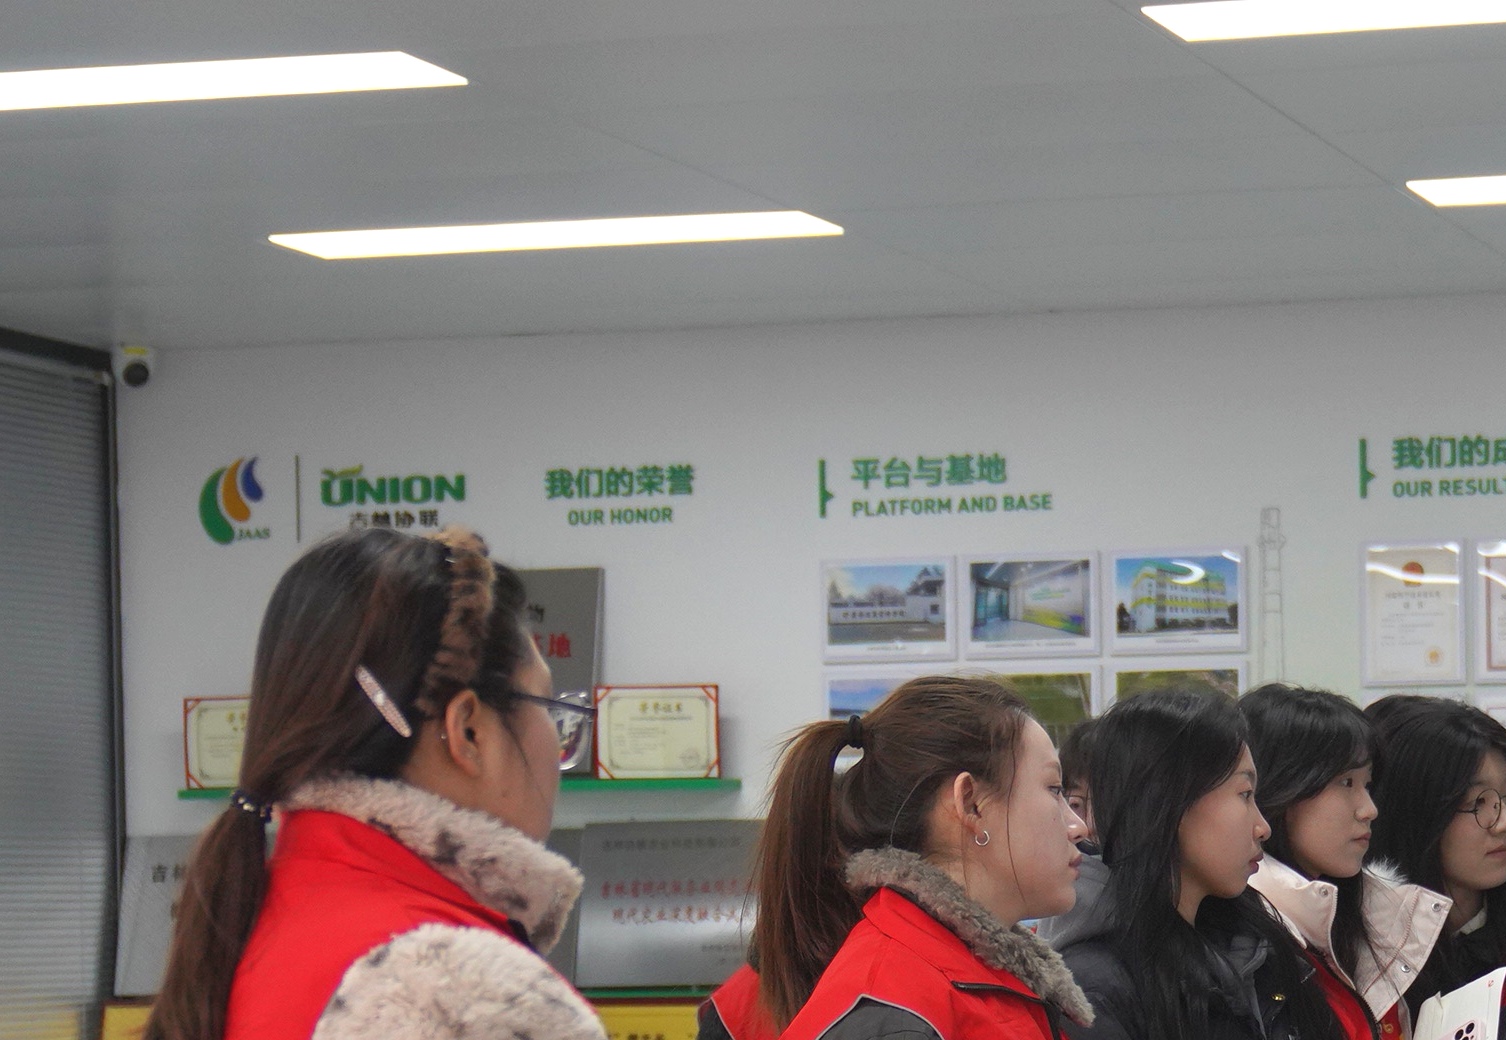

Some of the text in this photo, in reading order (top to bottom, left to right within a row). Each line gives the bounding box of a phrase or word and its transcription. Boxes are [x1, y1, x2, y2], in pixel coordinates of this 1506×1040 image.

[545, 464, 694, 499] 我们的荣誉
[851, 452, 1007, 489] 平台与基地
[320, 468, 465, 506] UNION
[1392, 479, 1432, 498] OUR
[567, 505, 673, 526] OUR HONOR
[852, 492, 1052, 517] PLATFORM AND BASE
